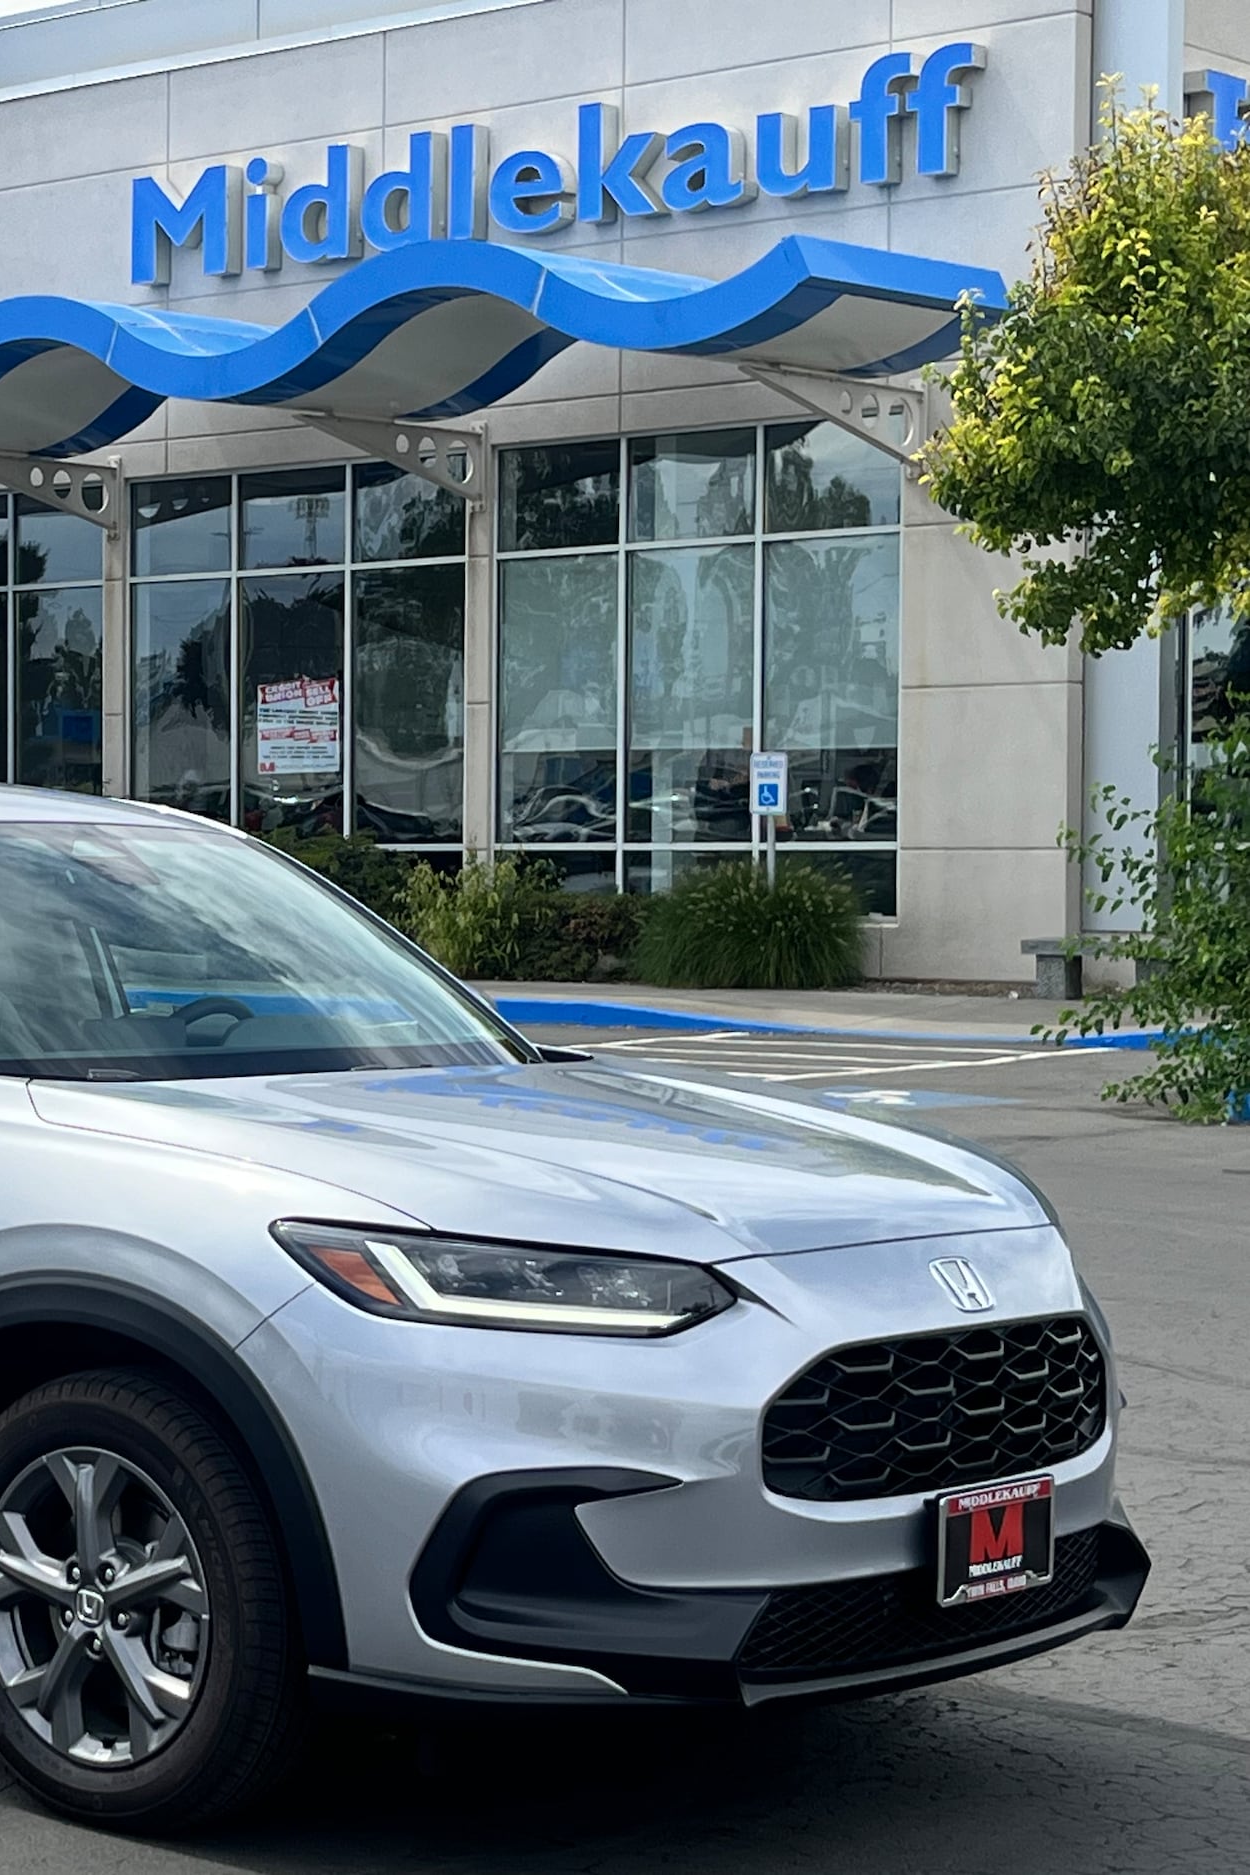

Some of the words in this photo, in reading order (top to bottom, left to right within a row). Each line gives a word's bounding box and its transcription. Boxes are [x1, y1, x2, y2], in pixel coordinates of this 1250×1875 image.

[131, 42, 982, 286] Middlekauff
[306, 685, 331, 697] SELL
[306, 694, 333, 707] OFF
[957, 1482, 1042, 1511] MIDDLEKAUFF
[970, 1502, 1024, 1565] M
